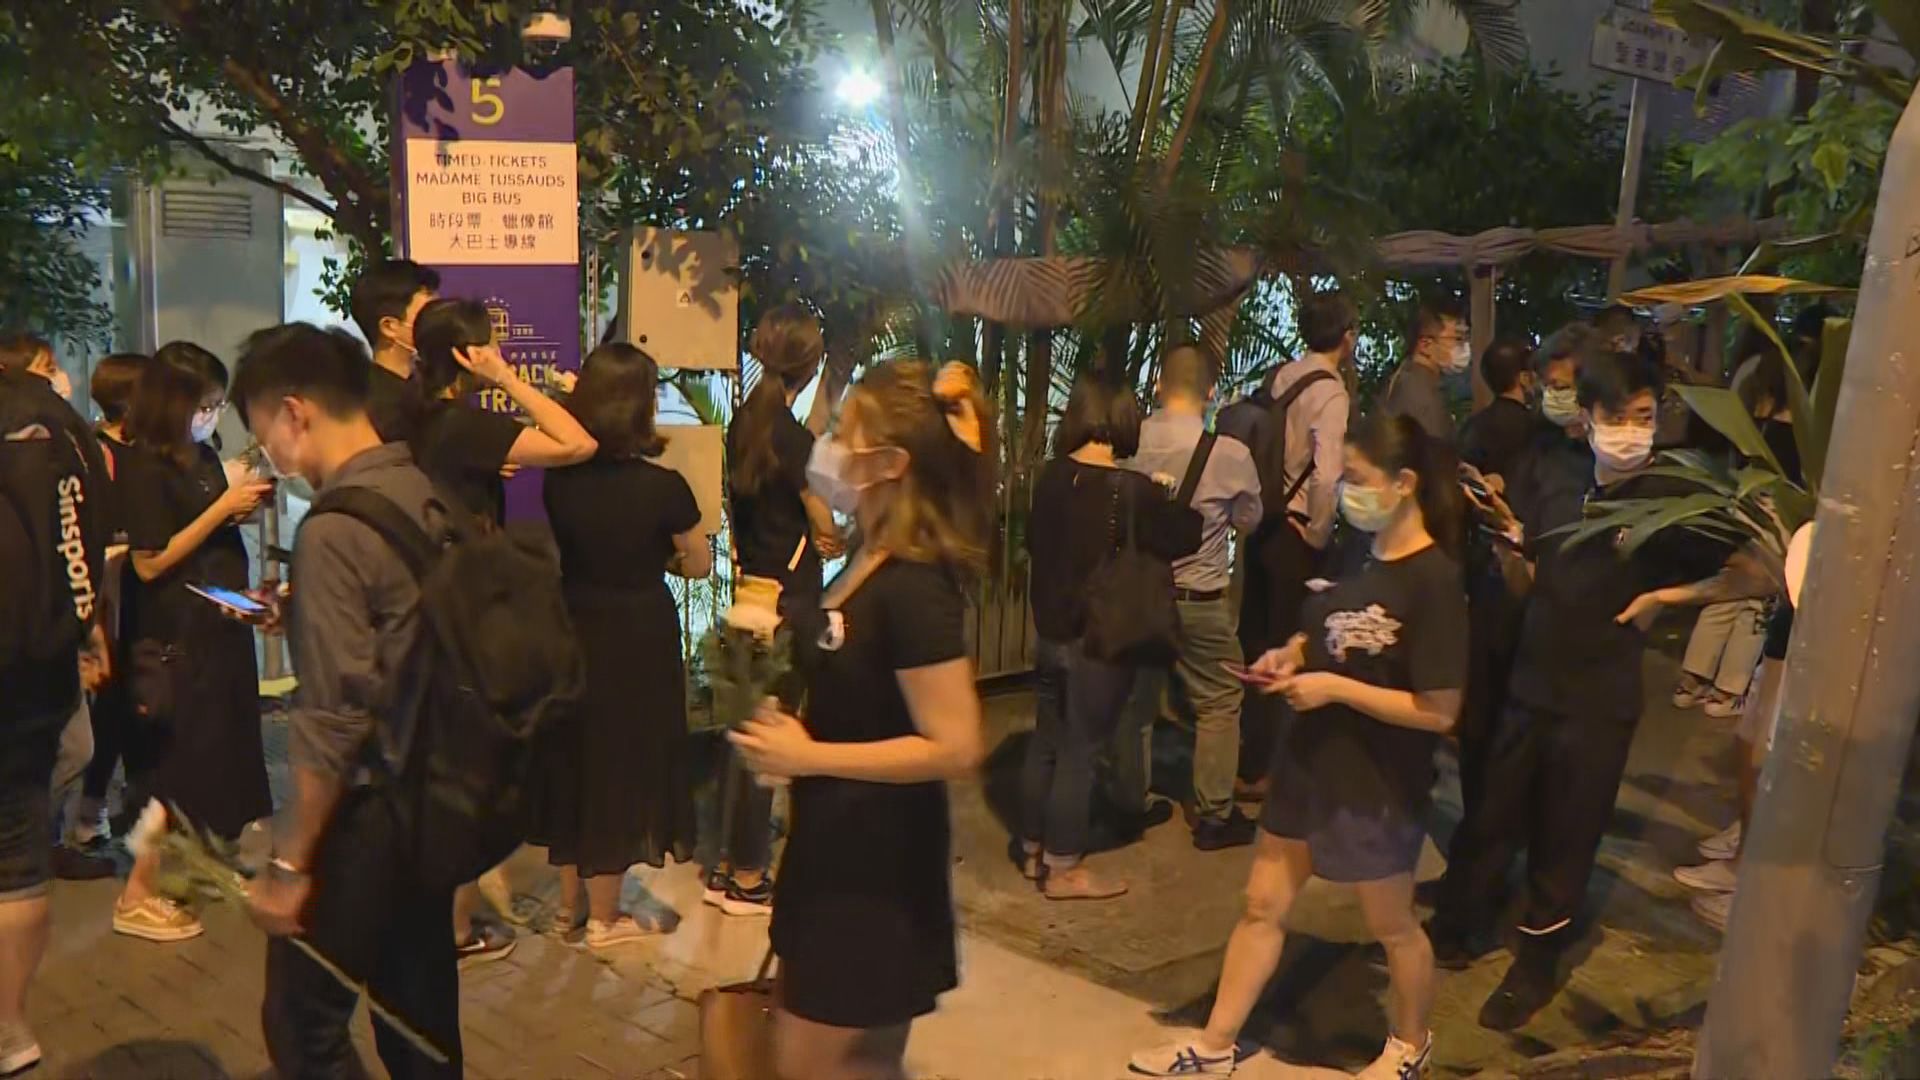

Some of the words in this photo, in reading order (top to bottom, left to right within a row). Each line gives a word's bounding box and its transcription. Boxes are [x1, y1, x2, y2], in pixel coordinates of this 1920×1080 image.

[471, 78, 504, 125] 5
[435, 153, 481, 168] TIMED
[489, 154, 547, 168] TICKETS
[416, 172, 481, 186] MADAME
[490, 173, 566, 187] TUSSAUDS
[462, 192, 487, 205] BIG
[492, 192, 522, 205] BUS
[56, 475, 96, 620] Sinsports
